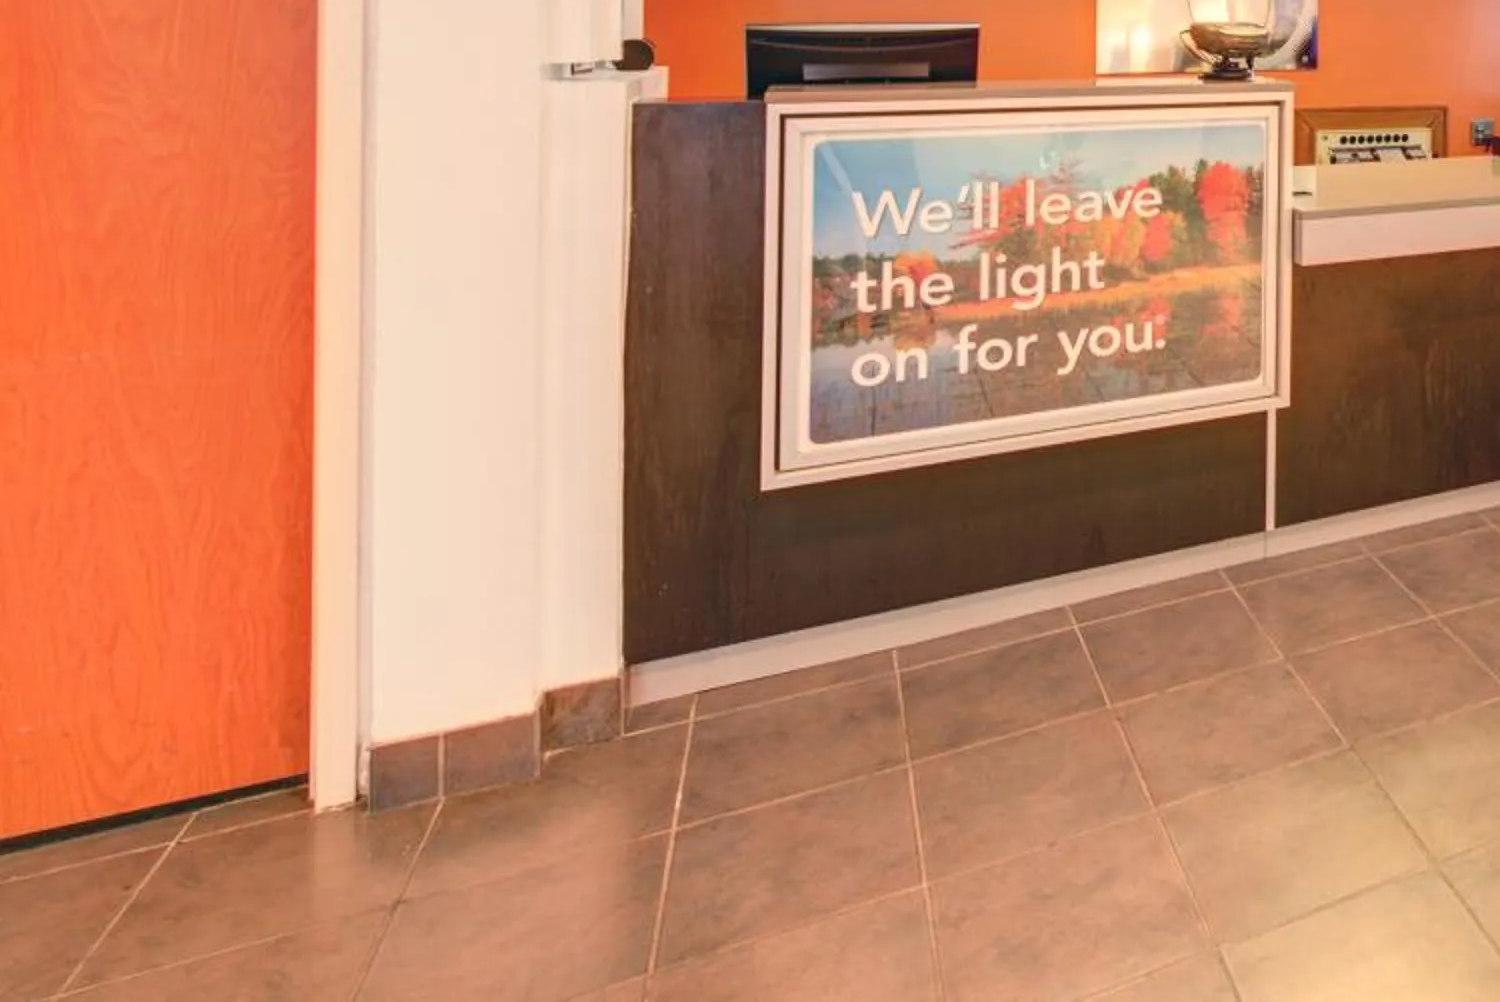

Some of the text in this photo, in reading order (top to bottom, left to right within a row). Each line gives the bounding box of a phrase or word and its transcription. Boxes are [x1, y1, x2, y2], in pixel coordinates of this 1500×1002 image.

[852, 176, 1164, 238] We'll leave
[850, 246, 1105, 313] the light
[851, 320, 1167, 387] on for you.
